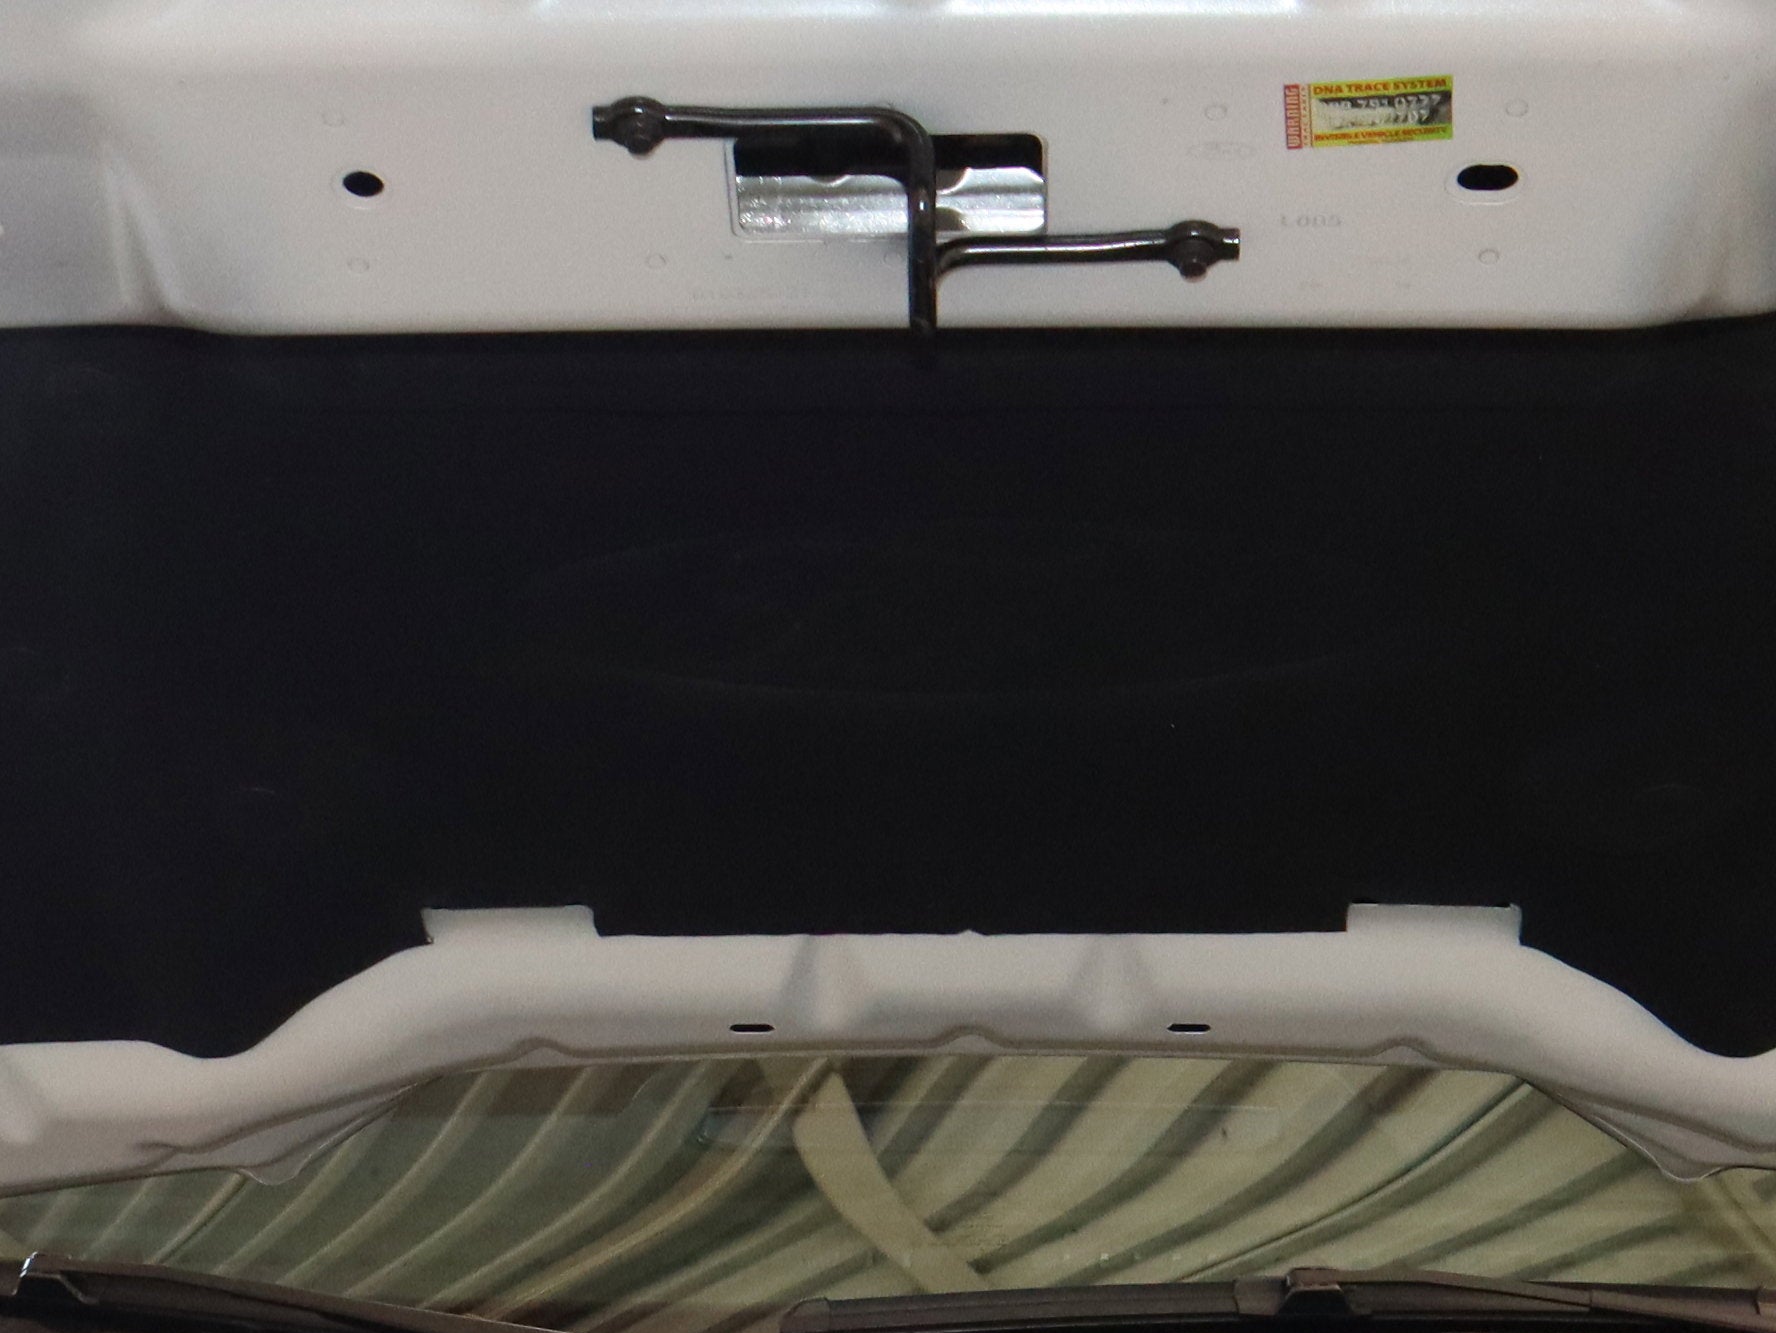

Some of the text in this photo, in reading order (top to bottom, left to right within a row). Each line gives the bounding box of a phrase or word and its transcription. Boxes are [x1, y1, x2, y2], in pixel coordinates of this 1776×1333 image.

[1313, 78, 1447, 95] DNA TRACE SYSTEM
